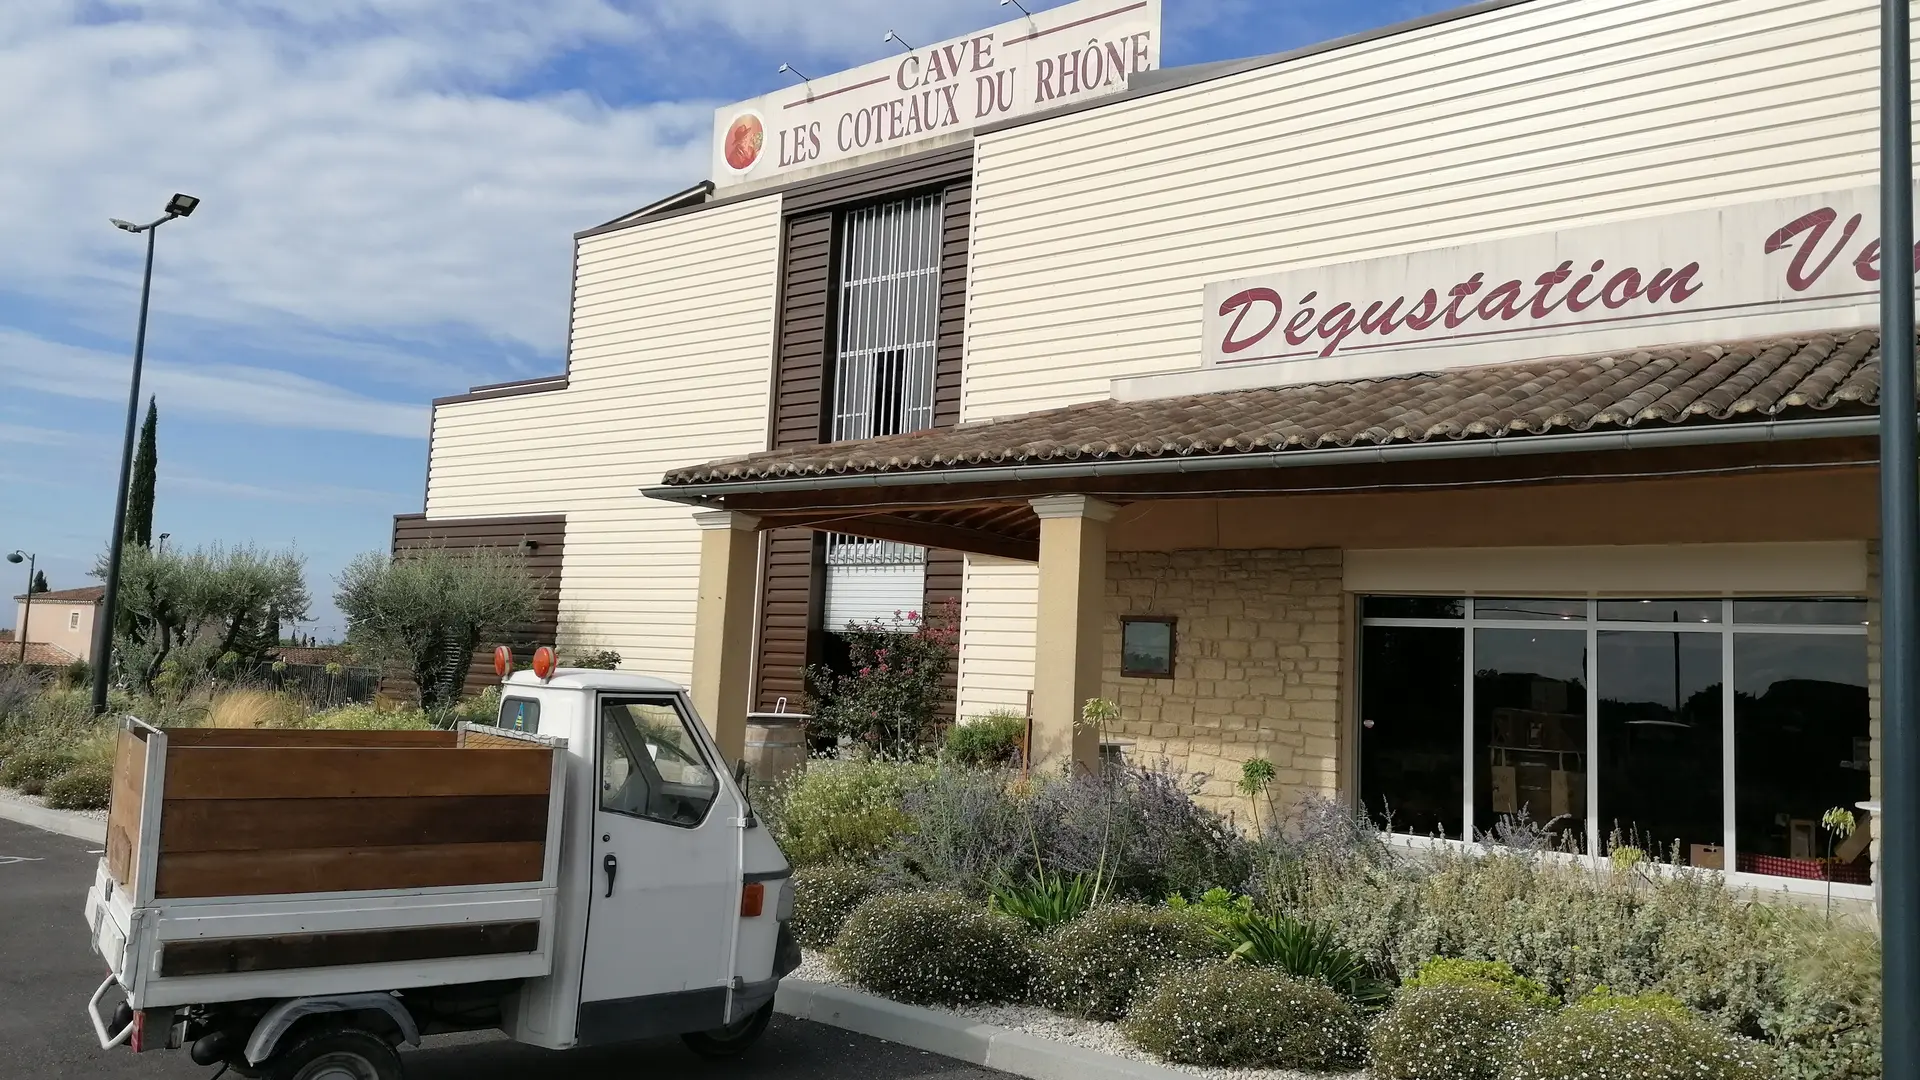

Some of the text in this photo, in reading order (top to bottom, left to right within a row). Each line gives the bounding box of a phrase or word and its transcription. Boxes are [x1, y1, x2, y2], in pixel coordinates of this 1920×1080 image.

[779, 30, 1151, 168] LES COTEAUX DU RHÔNE
[897, 33, 995, 91] CAVE
[1218, 259, 1704, 359] Dégustation
